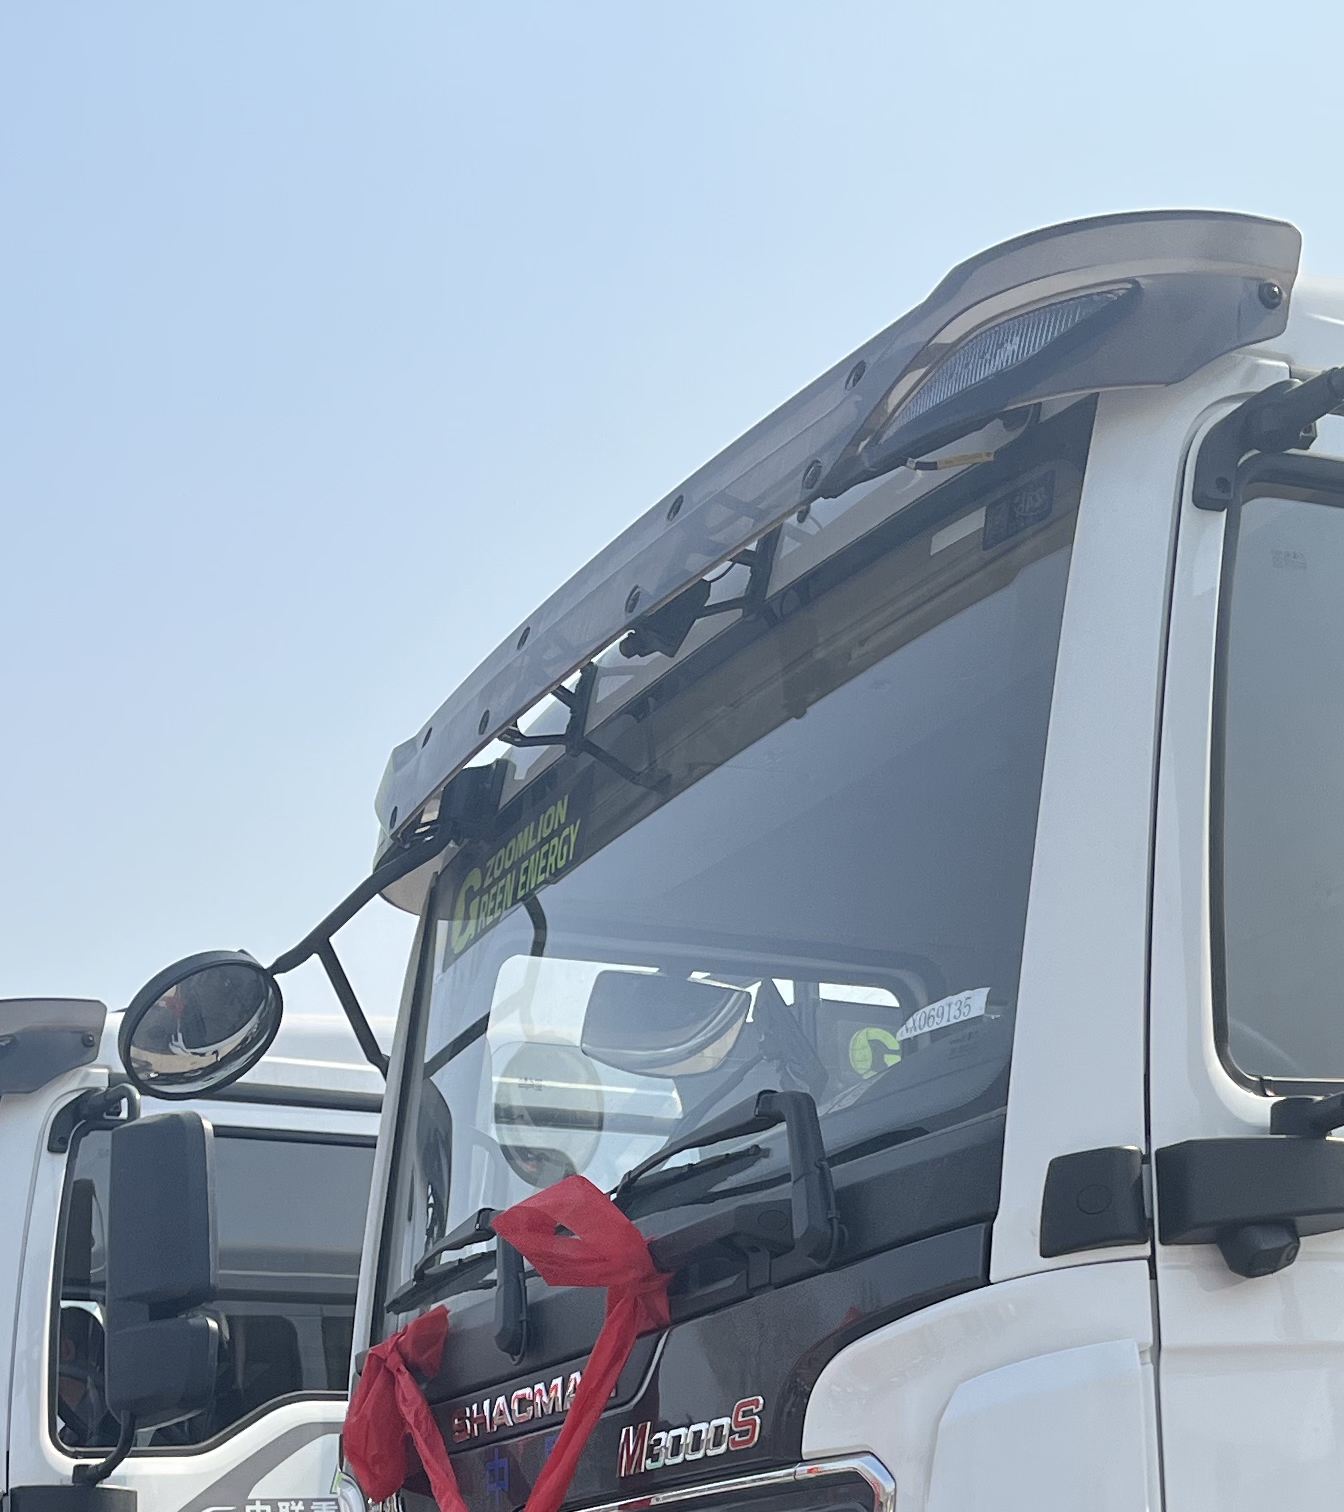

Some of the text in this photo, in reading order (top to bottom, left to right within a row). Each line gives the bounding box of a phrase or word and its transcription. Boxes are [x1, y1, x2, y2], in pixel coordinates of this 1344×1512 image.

[483, 793, 569, 889] ZOOMLION
[517, 818, 582, 900] ENERGY
[452, 1370, 618, 1444] SHACMA
[616, 1395, 765, 1478] M3000S
